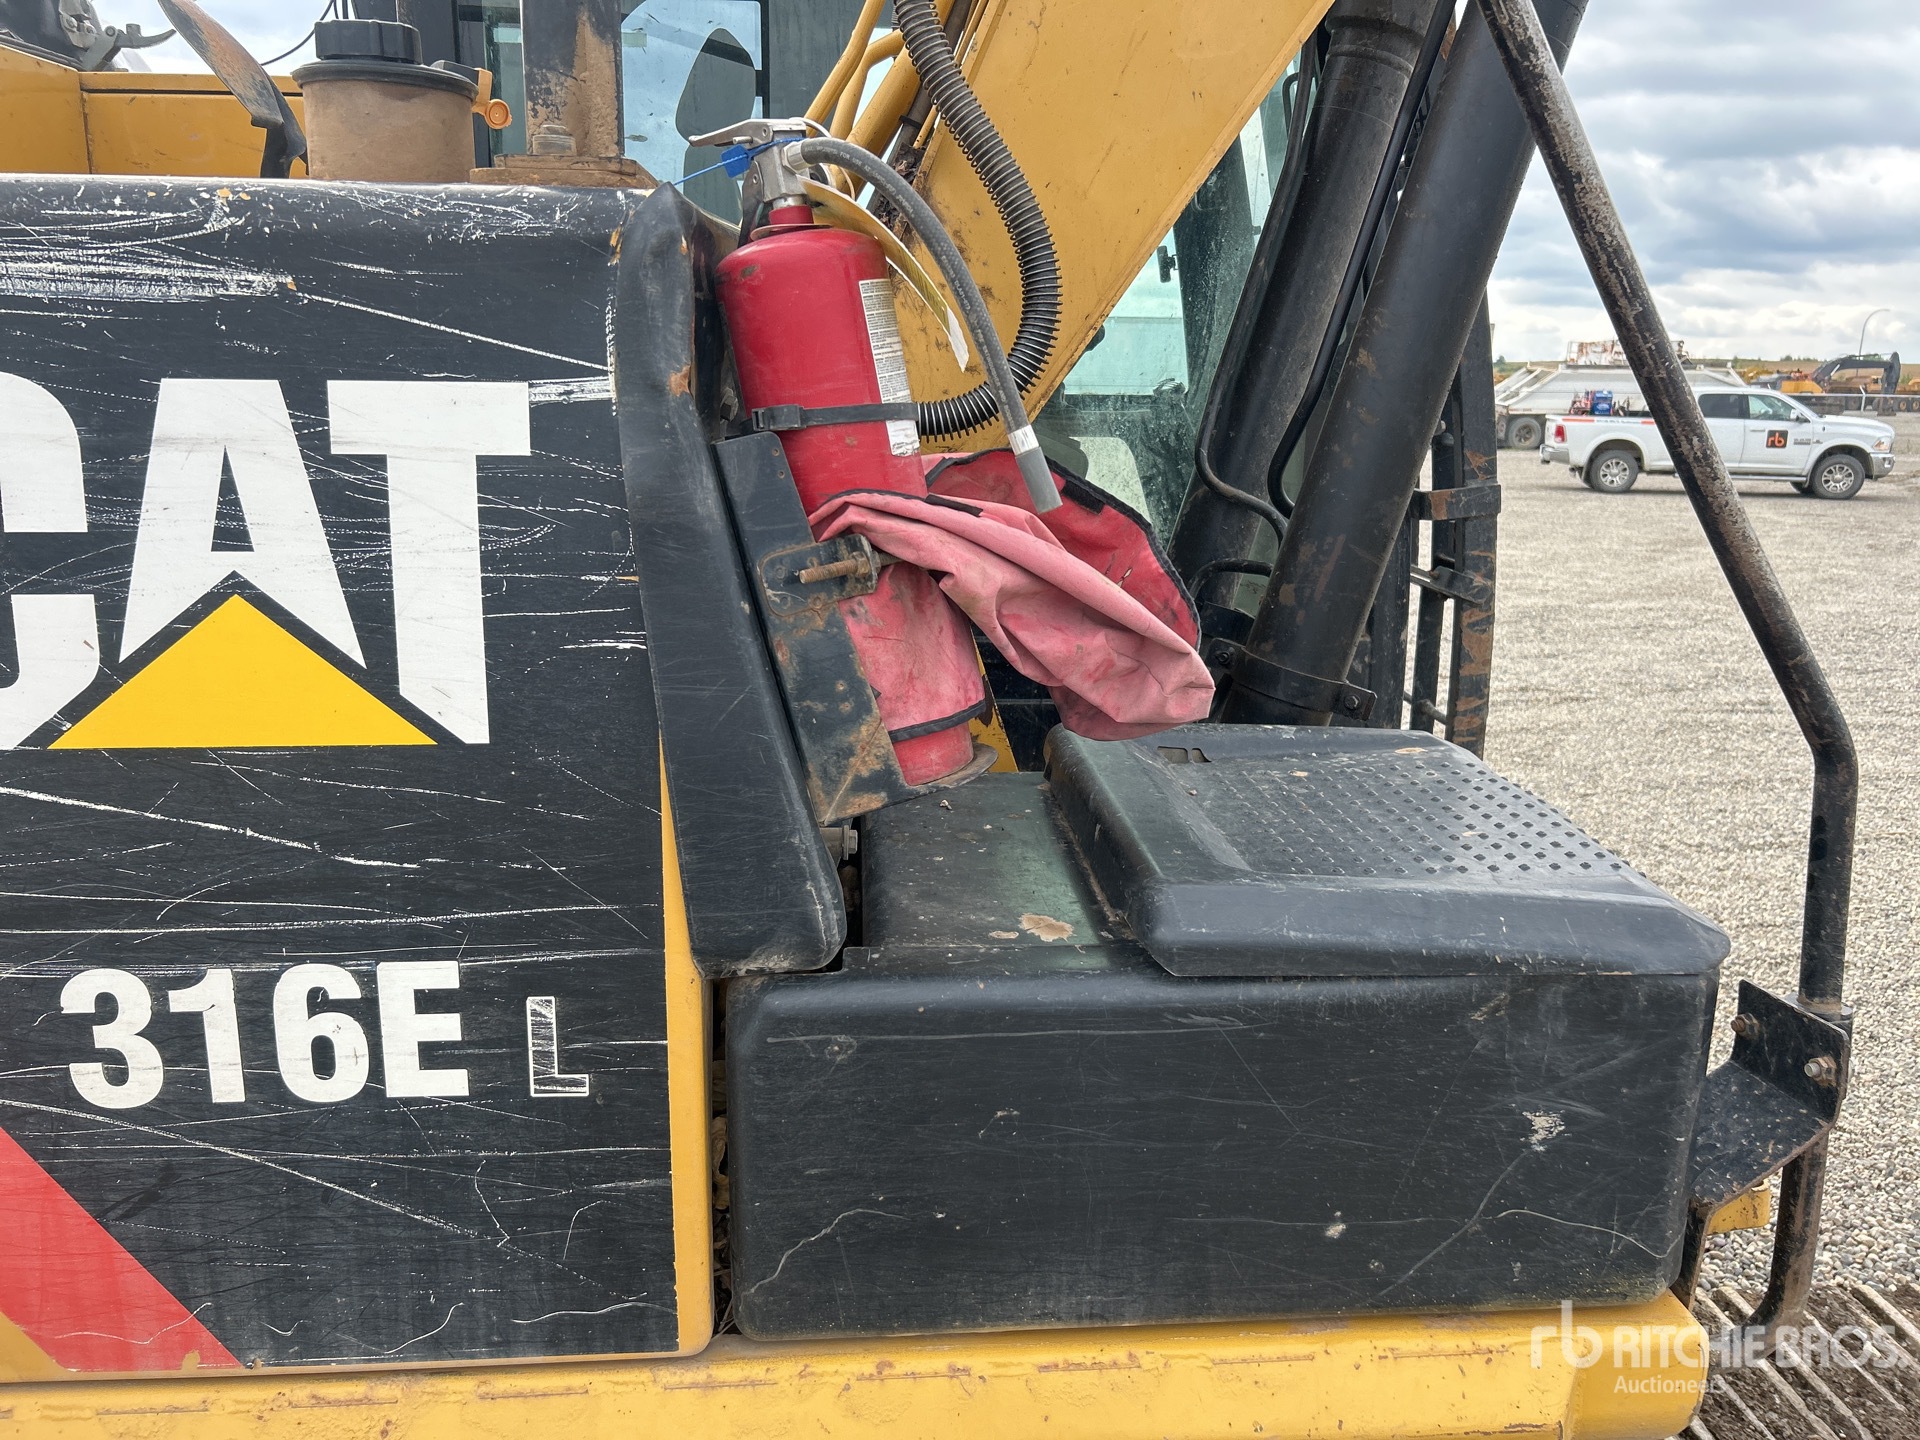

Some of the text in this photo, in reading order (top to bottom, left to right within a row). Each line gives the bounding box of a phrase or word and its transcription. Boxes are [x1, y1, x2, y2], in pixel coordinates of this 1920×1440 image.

[1767, 431, 1785, 447] rb
[60, 961, 590, 1110] 316E L
